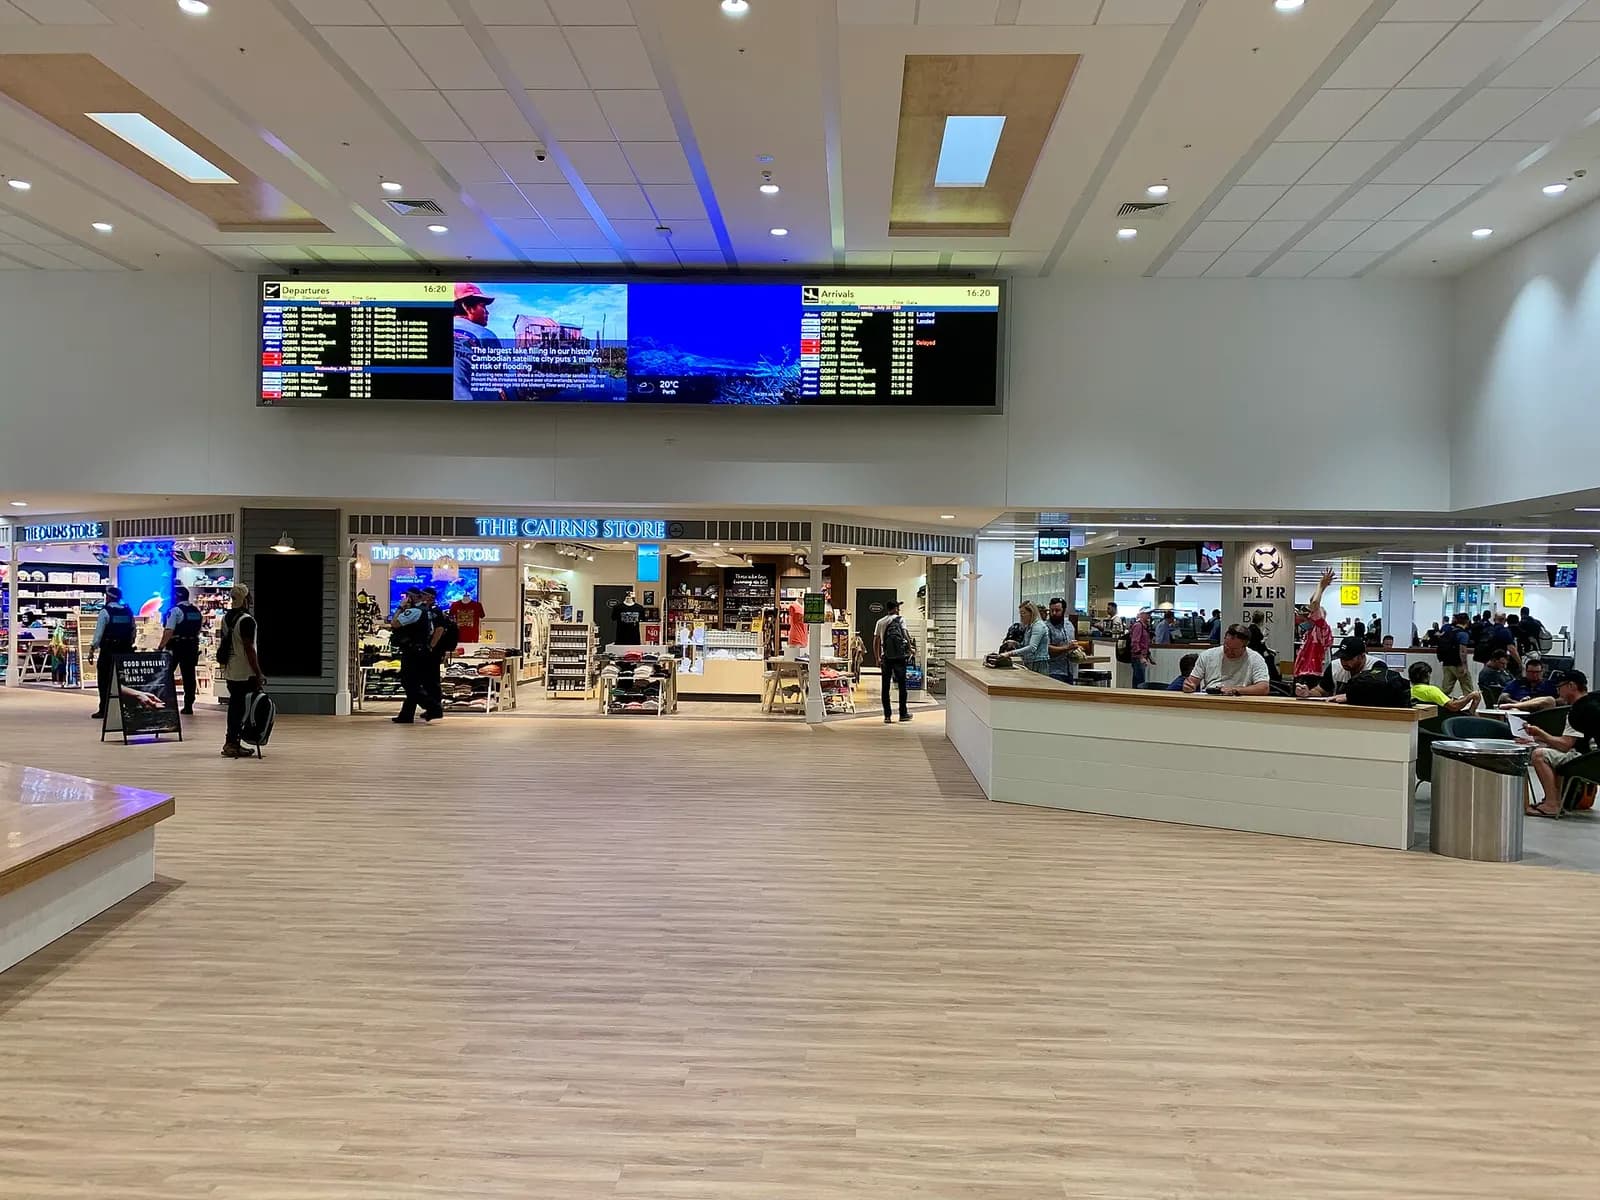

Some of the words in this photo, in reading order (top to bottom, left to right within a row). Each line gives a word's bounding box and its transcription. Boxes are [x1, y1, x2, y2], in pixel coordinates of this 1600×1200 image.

[283, 286, 330, 297] Departures
[424, 285, 447, 294] 16:20
[821, 288, 855, 299] Arrivals
[967, 288, 992, 298] 16:20
[488, 346, 512, 356] largest
[529, 346, 548, 356] filling
[549, 347, 556, 355] in
[471, 354, 511, 362] Cambodian
[512, 354, 540, 362] satellite
[541, 355, 554, 364] city
[555, 355, 571, 364] puts
[579, 355, 602, 363] million
[480, 362, 492, 370] risk
[494, 362, 501, 370] of
[503, 362, 532, 372] flooding
[476, 518, 517, 536] THE
[521, 519, 598, 537] CAIRNS
[602, 520, 666, 539] STORE
[371, 546, 400, 561] THE
[401, 546, 455, 561] CAIRNS
[457, 548, 501, 562] STORE
[1242, 576, 1259, 584] THE
[1243, 586, 1286, 599] PIER
[1344, 590, 1358, 601] 18
[1508, 592, 1521, 603] 17
[1243, 610, 1274, 623] BR
